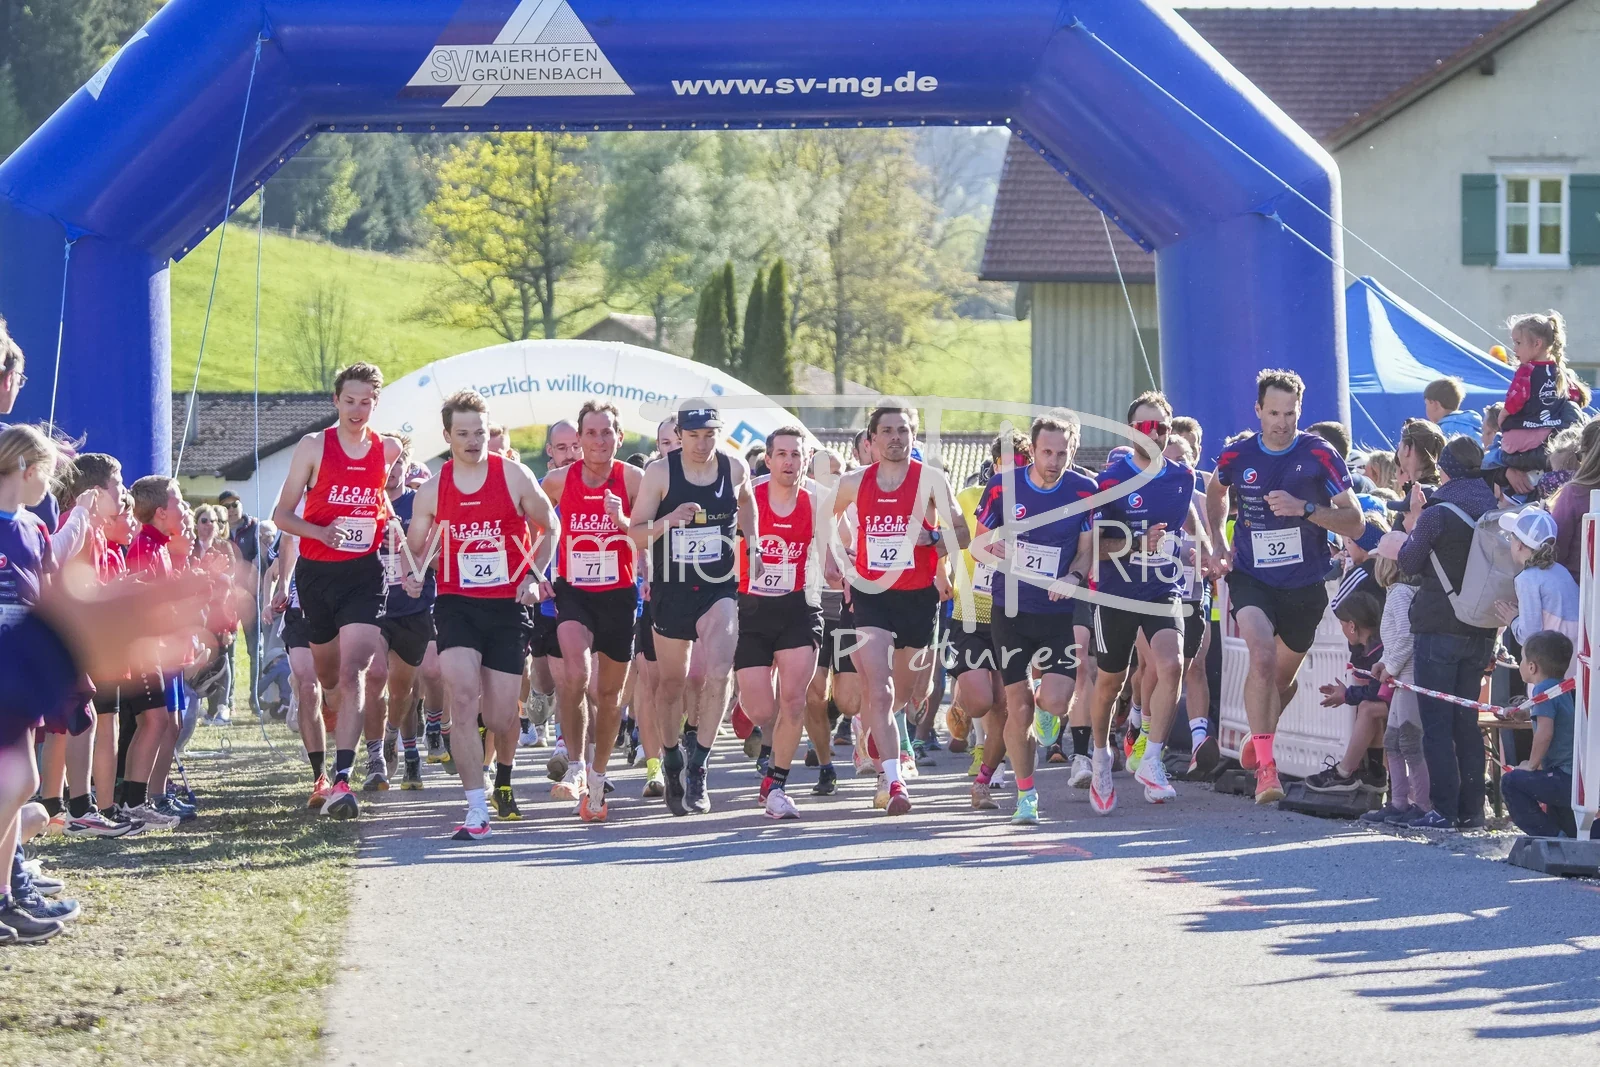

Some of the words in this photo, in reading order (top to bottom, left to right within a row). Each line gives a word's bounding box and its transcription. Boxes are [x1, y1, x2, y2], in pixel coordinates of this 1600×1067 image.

[475, 46, 598, 63] MAIERHÖFEN
[431, 49, 474, 82] SV
[472, 66, 602, 81] GRÜNENBACH
[671, 71, 939, 98] www.sv-mg.de
[330, 485, 379, 497] SPORT
[328, 493, 377, 505] HASCHKO
[570, 513, 610, 522] SPOR
[449, 519, 502, 532] SPORT
[866, 523, 910, 532] HASCHK
[345, 528, 363, 542] 38
[450, 527, 501, 539] HASCHKO
[762, 547, 803, 557] ASCHKO
[880, 548, 898, 560] 42
[1267, 541, 1287, 556] 32
[1025, 555, 1042, 569] 21
[474, 564, 493, 577] 24
[585, 562, 603, 576] 77
[764, 574, 782, 587] 67
[983, 574, 993, 586] 1
